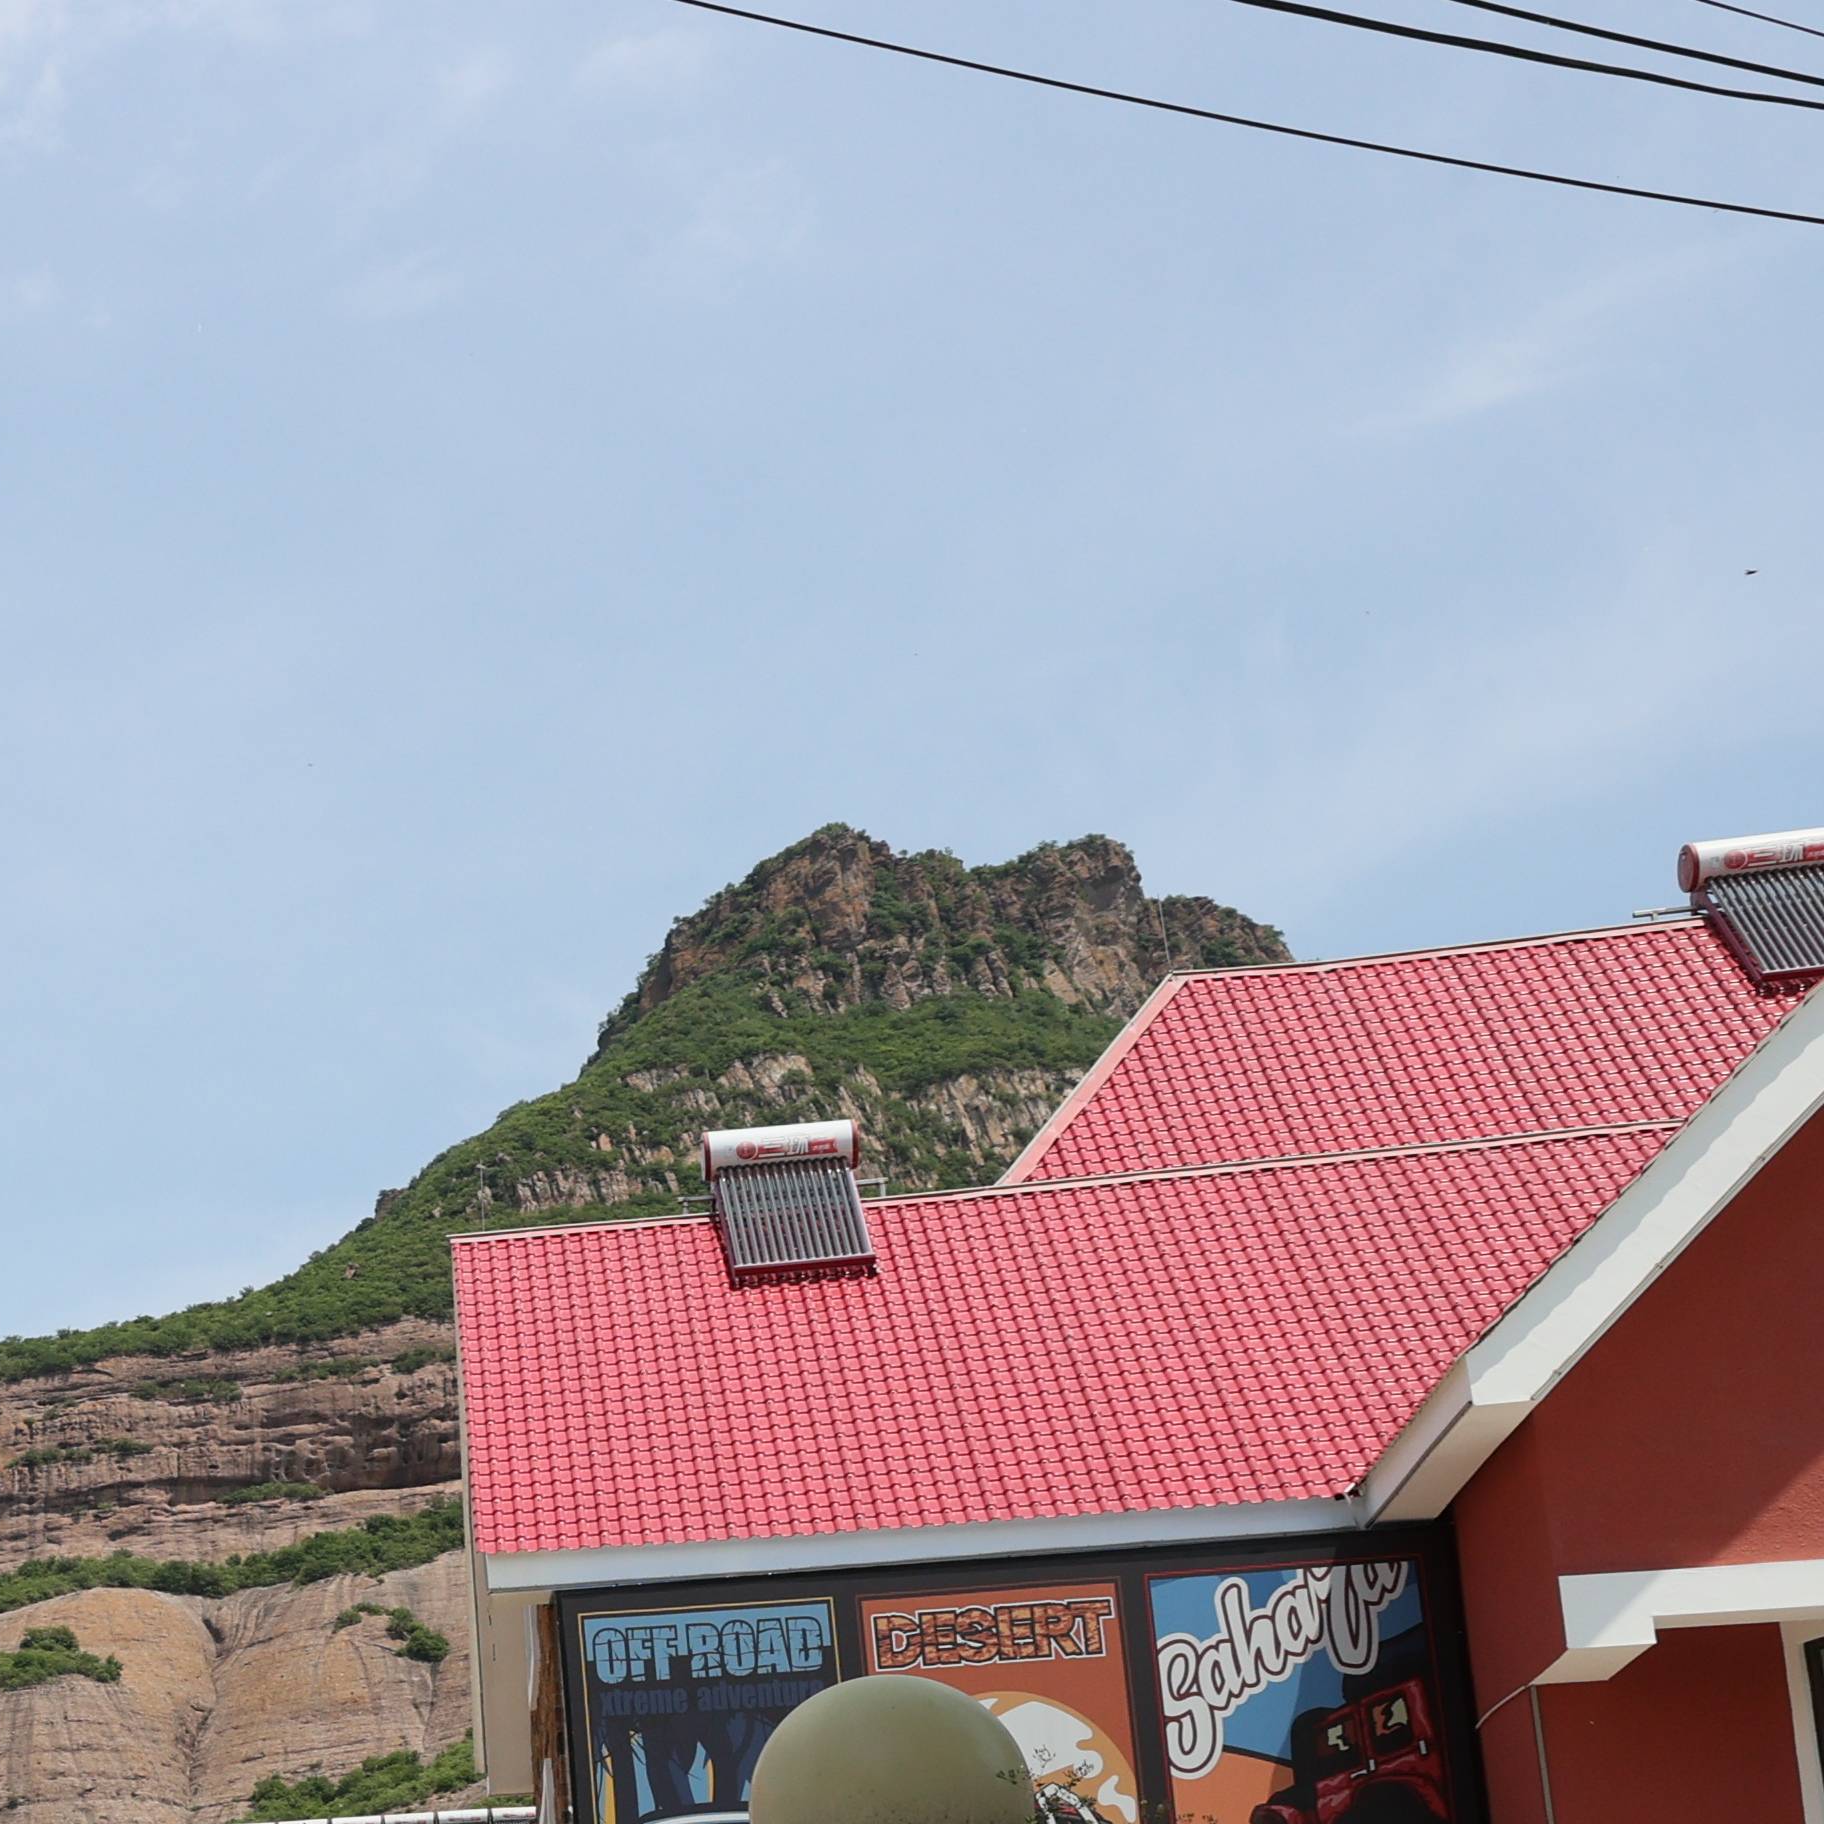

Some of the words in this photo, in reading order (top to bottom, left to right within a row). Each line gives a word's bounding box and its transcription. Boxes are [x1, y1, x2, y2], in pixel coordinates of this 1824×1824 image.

[592, 1624, 678, 1685] OFF
[685, 1615, 824, 1679] ROAD
[871, 1597, 1116, 1672] DESERT
[601, 1685, 689, 1717] xtreme
